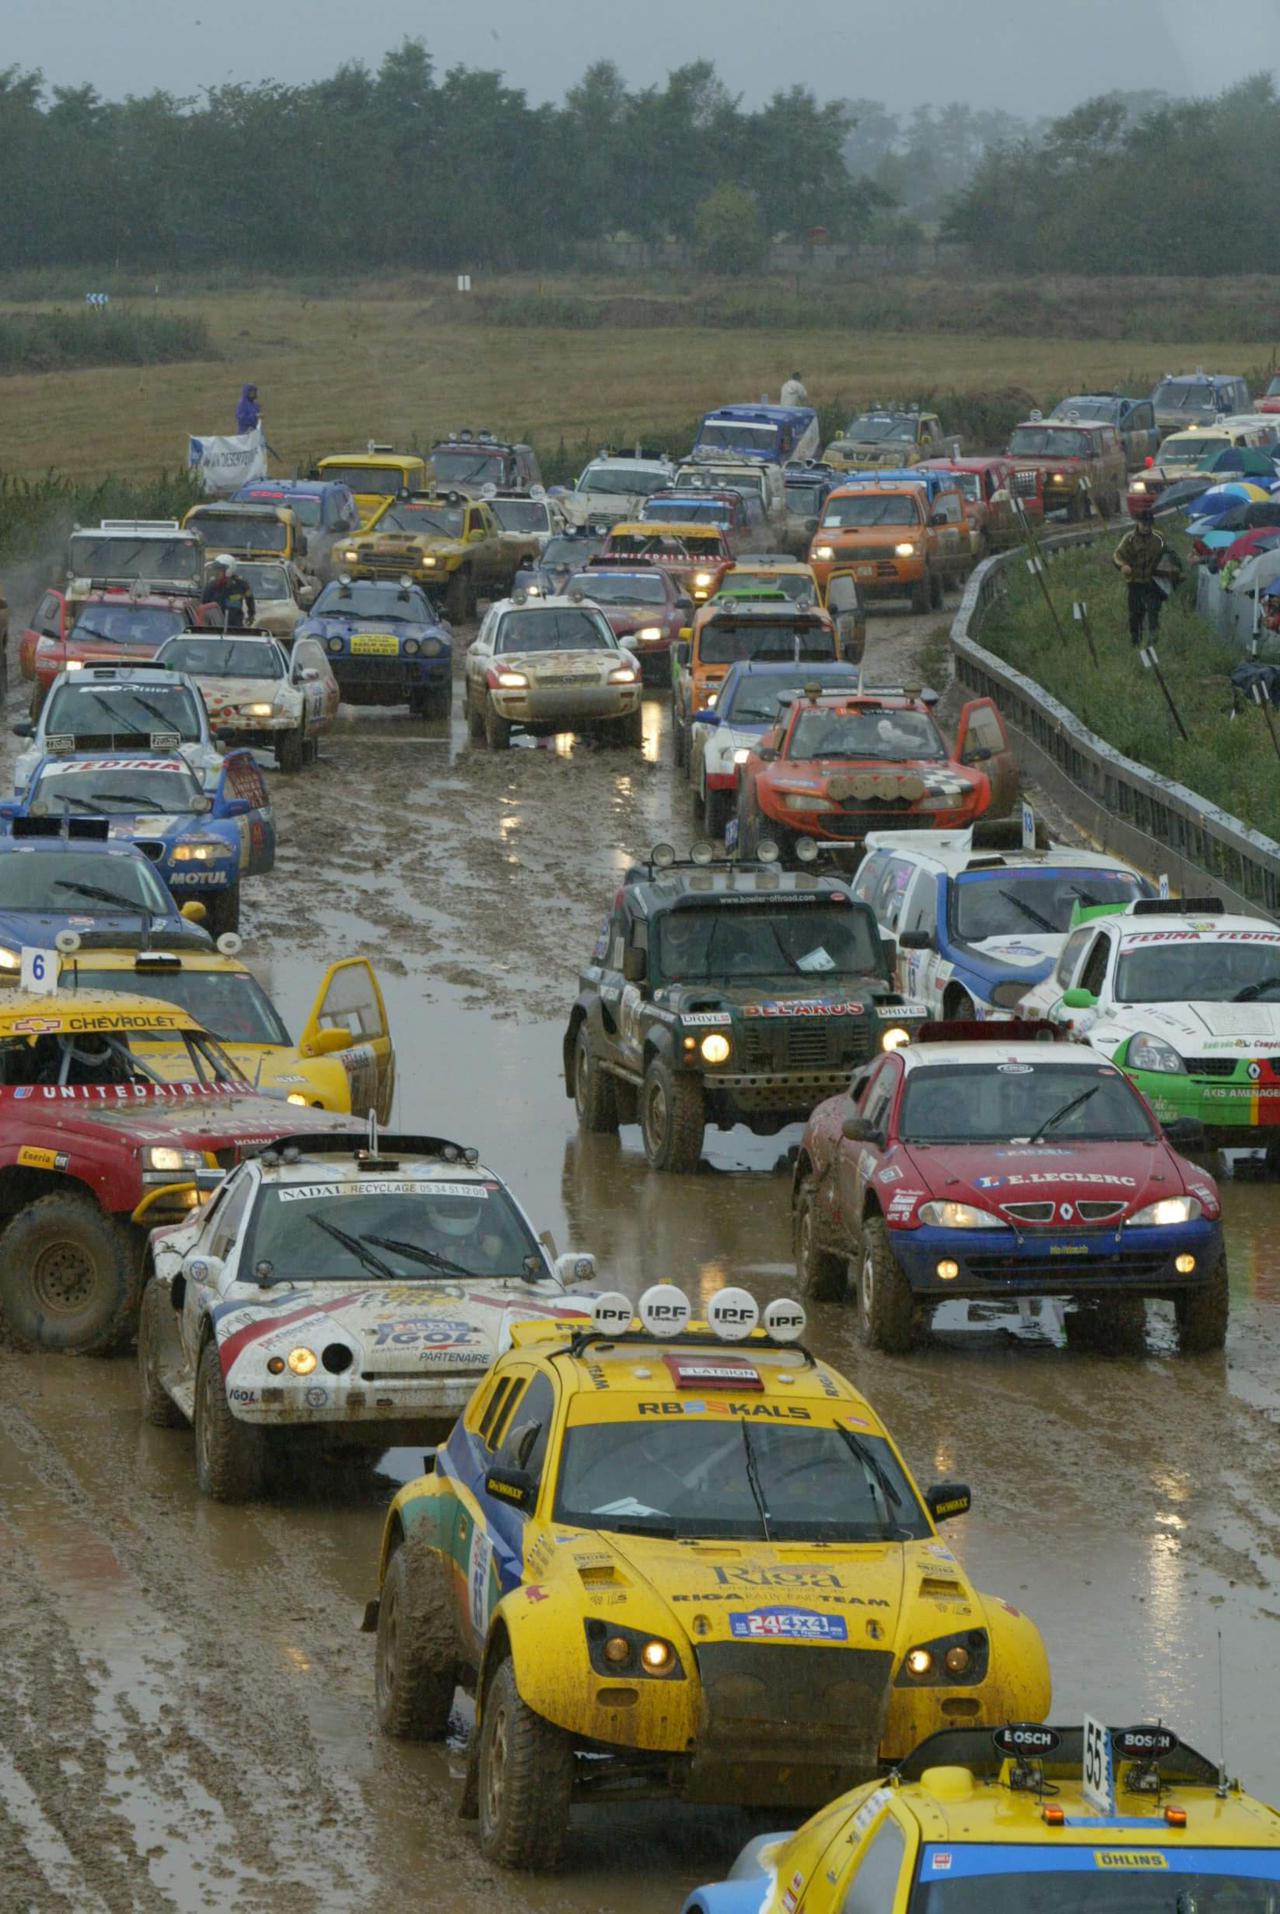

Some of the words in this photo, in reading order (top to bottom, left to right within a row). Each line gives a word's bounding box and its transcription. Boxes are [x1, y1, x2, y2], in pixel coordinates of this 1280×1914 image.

[62, 759, 181, 773] FEDIMA
[169, 870, 228, 885] MOTUL
[1127, 932, 1201, 945] FEDIMA
[32, 954, 45, 981] 6
[743, 1002, 865, 1017] BELARUS
[879, 1007, 917, 1017] DRIVE
[69, 1015, 176, 1030] CHEVROLET
[682, 1015, 720, 1025] DRIVE
[1008, 1172, 1137, 1188] E.LECLERC
[351, 1183, 417, 1194] RECYCLAGE
[595, 1308, 631, 1322] IPF
[648, 1304, 687, 1318] IPF
[714, 1307, 755, 1321] IPF
[769, 1315, 804, 1327] IPF
[419, 1351, 491, 1364] PARTENAIRE
[588, 1362, 610, 1390] TEAM
[689, 1367, 757, 1378] LATSIGN
[229, 1388, 256, 1402] IGOL
[671, 1592, 744, 1602] RIGA
[817, 1594, 891, 1607] TEAM
[1085, 1721, 1102, 1791] 55
[1101, 1853, 1163, 1866] ÖHLINS
